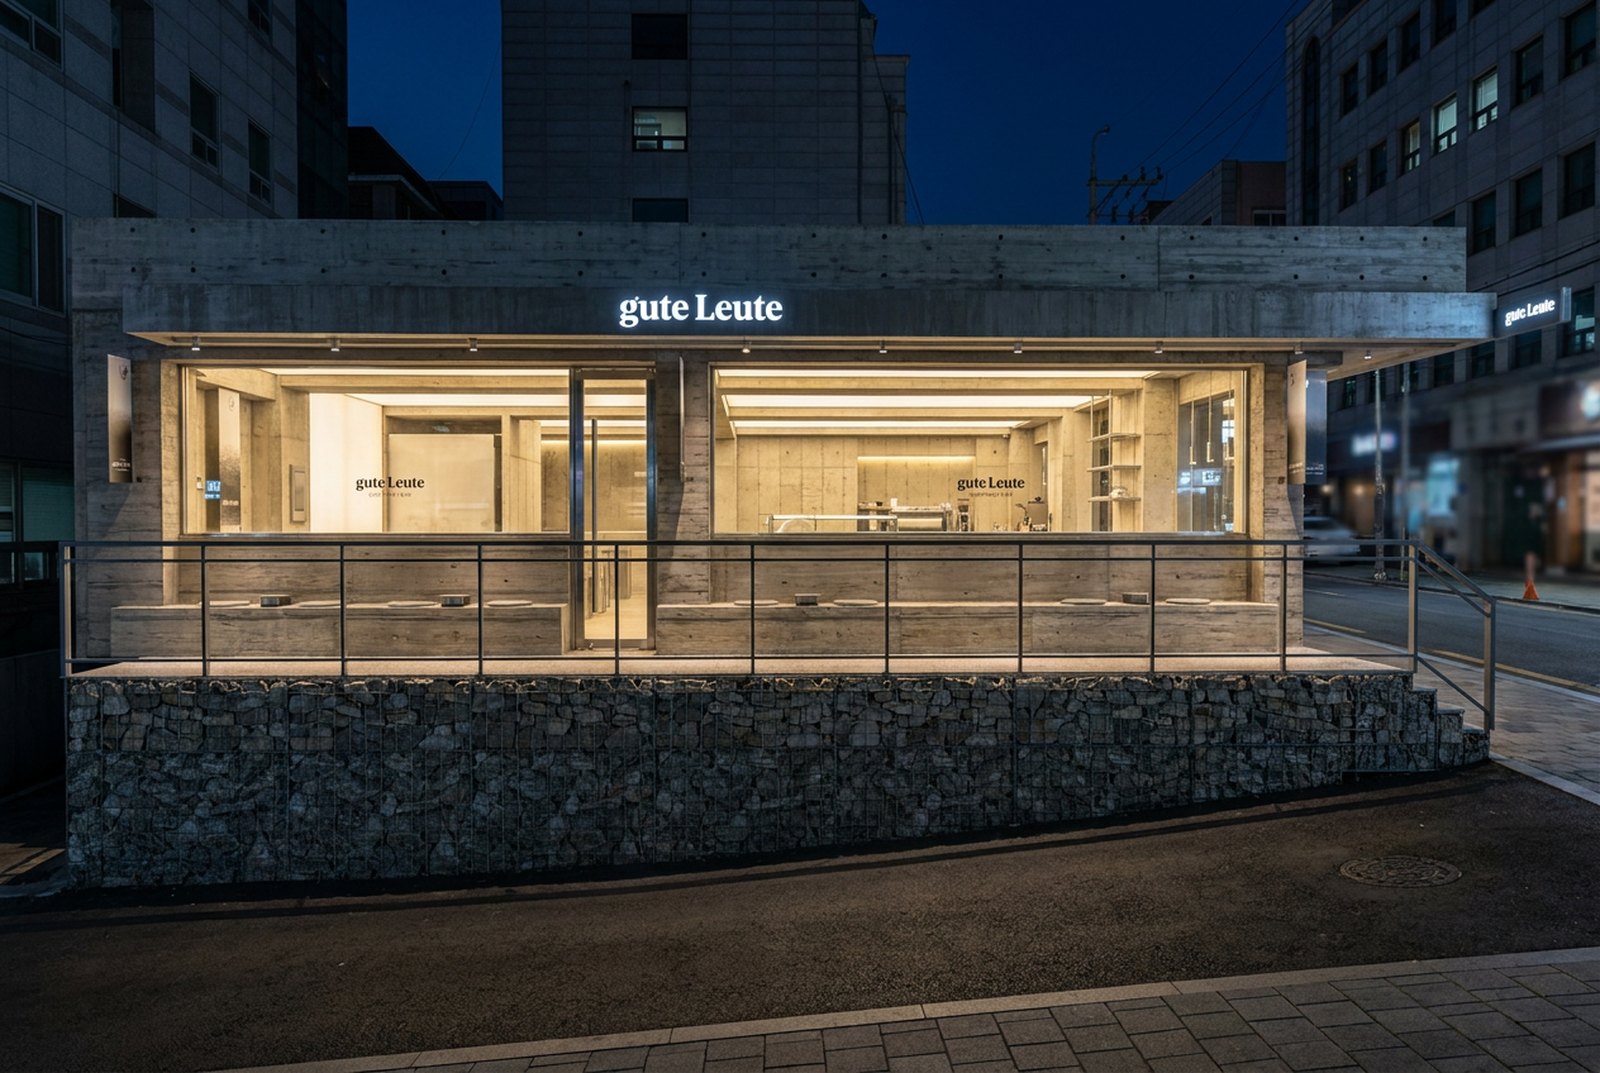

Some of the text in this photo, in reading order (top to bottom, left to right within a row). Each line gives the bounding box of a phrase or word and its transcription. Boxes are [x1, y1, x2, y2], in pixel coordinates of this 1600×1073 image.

[619, 294, 783, 328] gute Leute
[1527, 299, 1555, 317] Leute
[356, 476, 425, 491] gute Leute
[957, 476, 1025, 491] gute Leute
